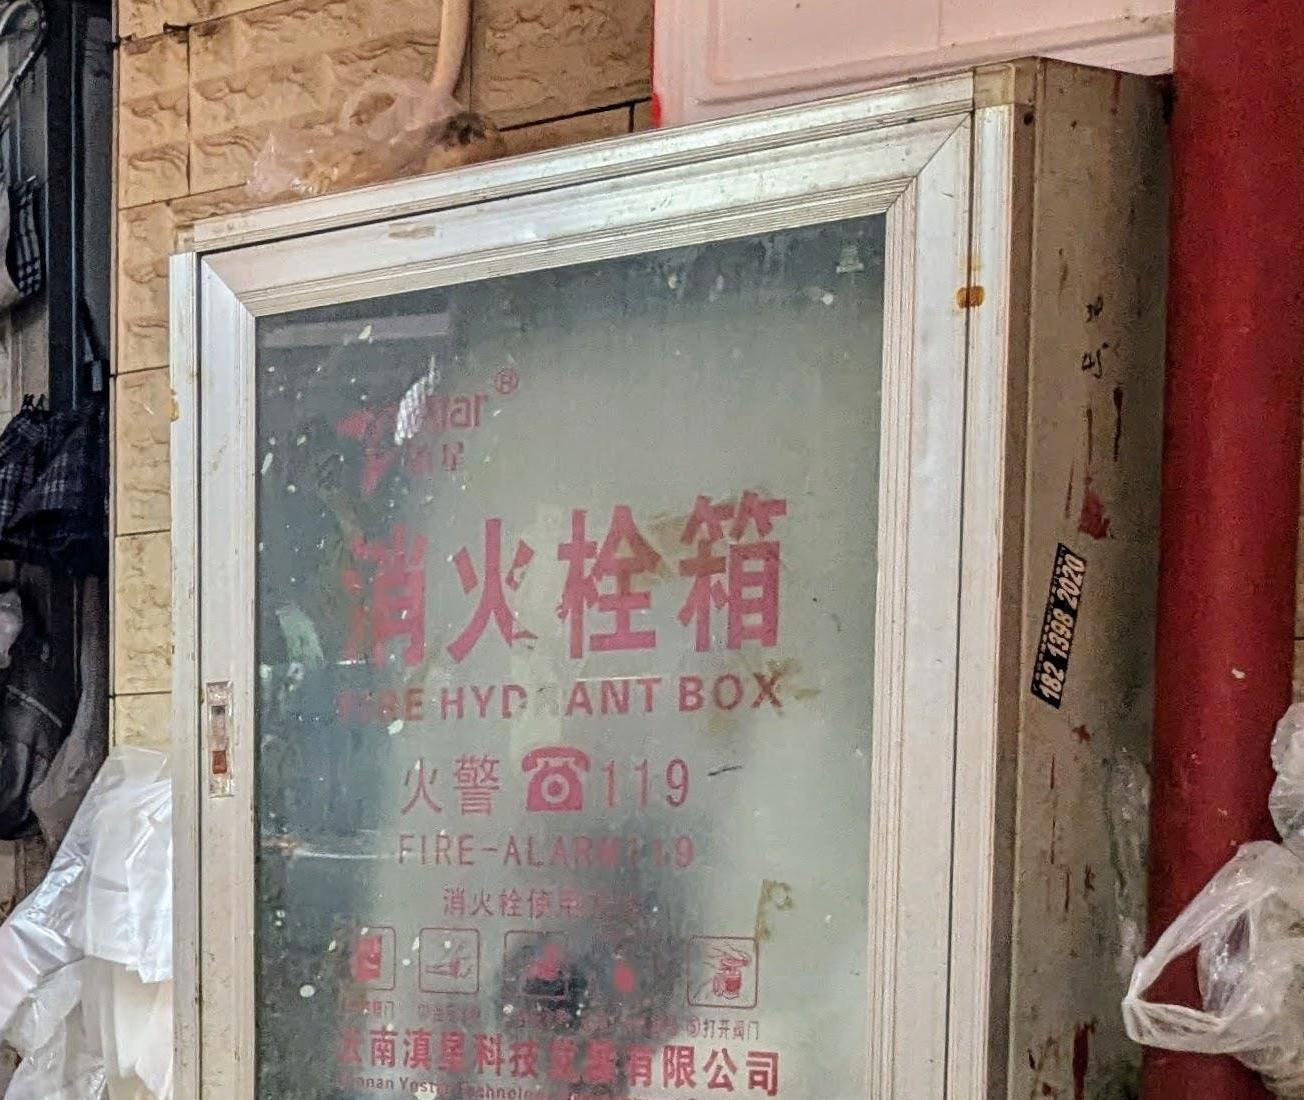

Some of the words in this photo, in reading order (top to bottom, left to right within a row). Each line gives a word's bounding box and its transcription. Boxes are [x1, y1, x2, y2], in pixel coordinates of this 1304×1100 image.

[343, 490, 787, 666] 消火栓箱
[1056, 553, 1086, 610] 2020
[1046, 608, 1075, 660] 1398
[439, 677, 663, 720] HYDANT
[678, 673, 783, 712] BOX
[1039, 660, 1065, 700] 182
[400, 755, 499, 816] 火警
[604, 758, 691, 808] 119
